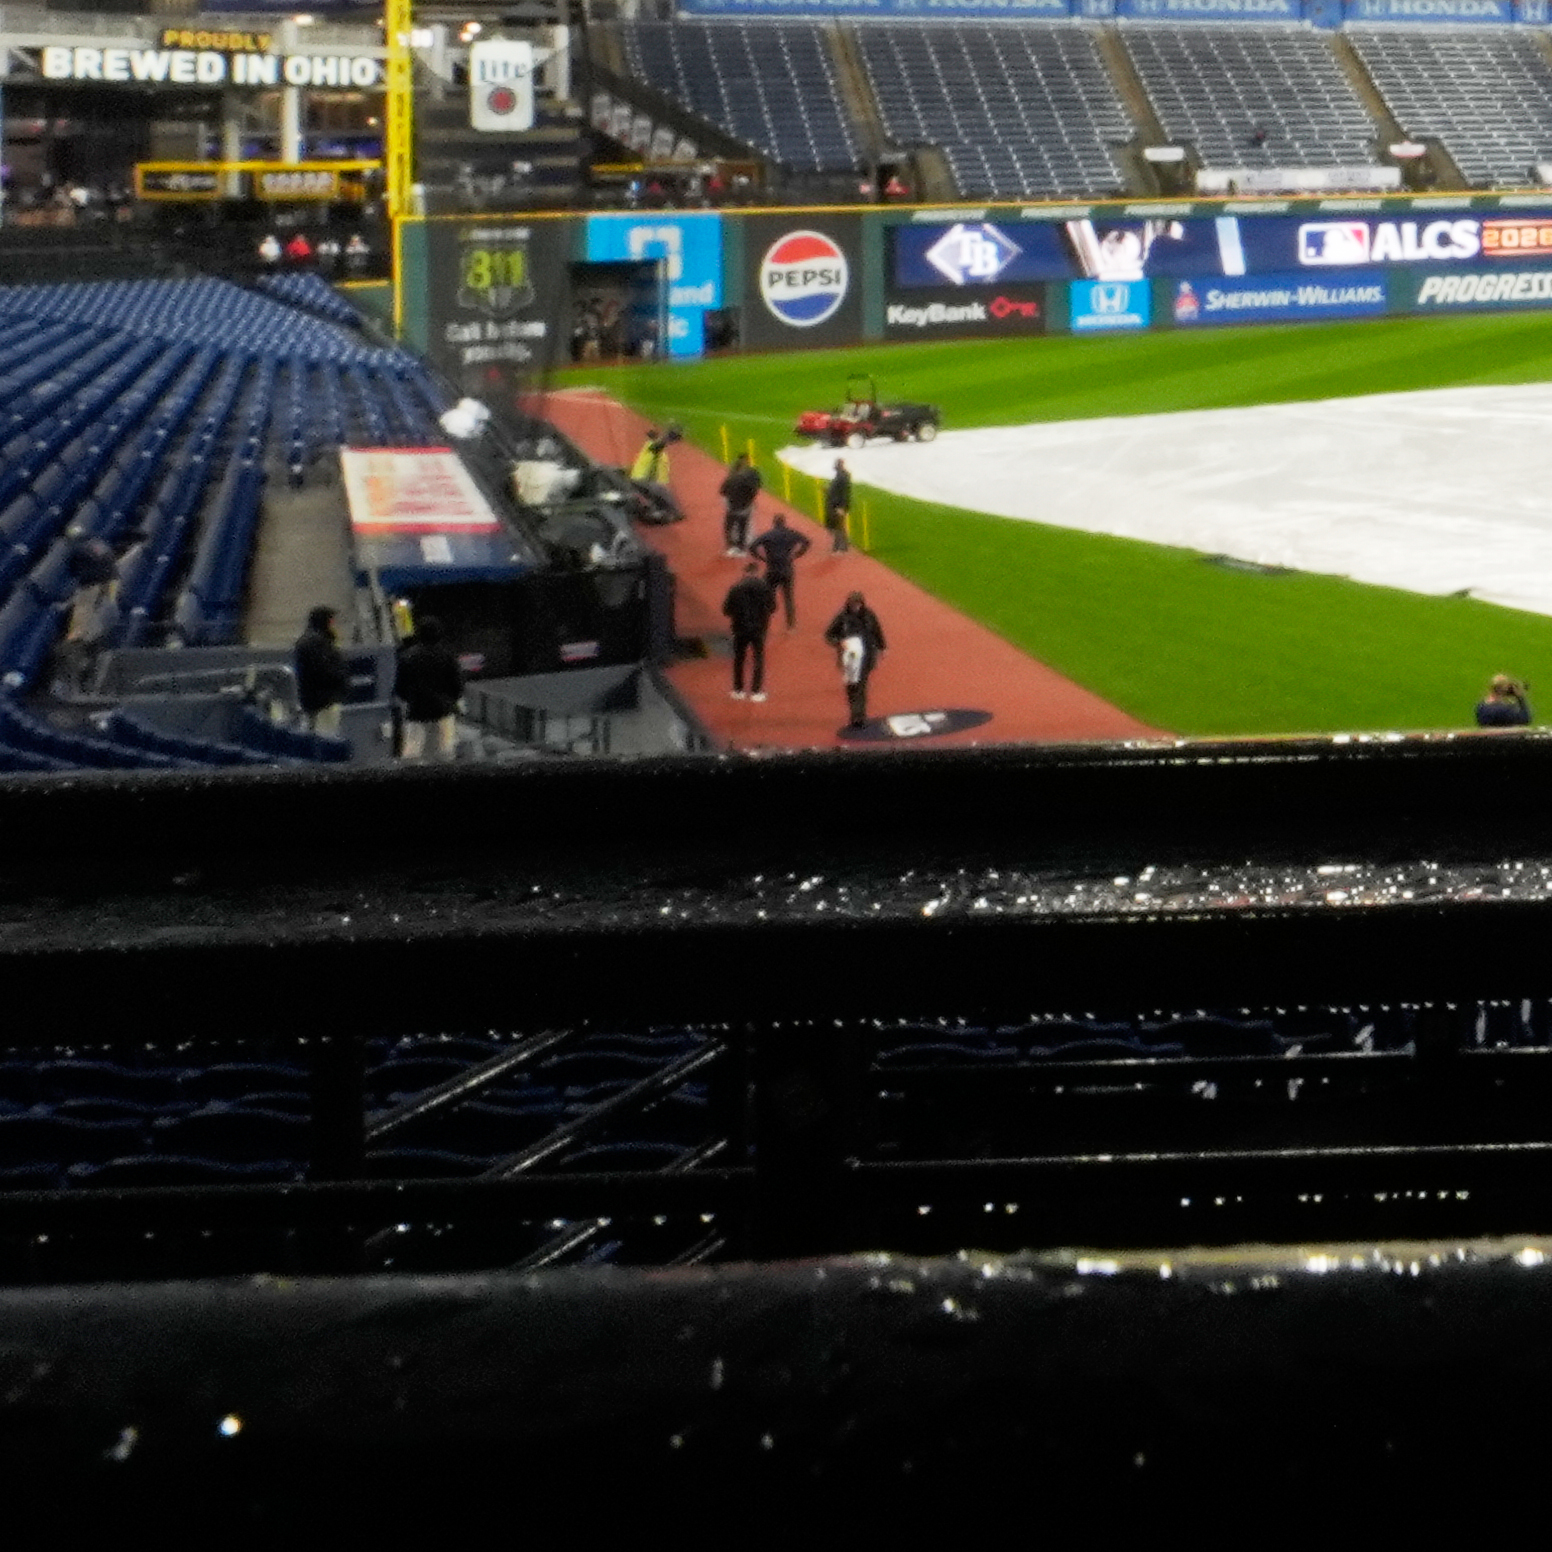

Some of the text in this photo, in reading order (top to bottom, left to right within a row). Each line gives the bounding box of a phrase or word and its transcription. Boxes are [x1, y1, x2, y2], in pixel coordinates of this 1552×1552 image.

[162, 28, 272, 51] PROUDLY
[41, 45, 380, 87] BREWED IN OHIO
[479, 56, 529, 83] Lite
[1371, 219, 1481, 262] ALCS
[766, 267, 844, 291] PEPSI
[887, 300, 988, 327] KeyBank
